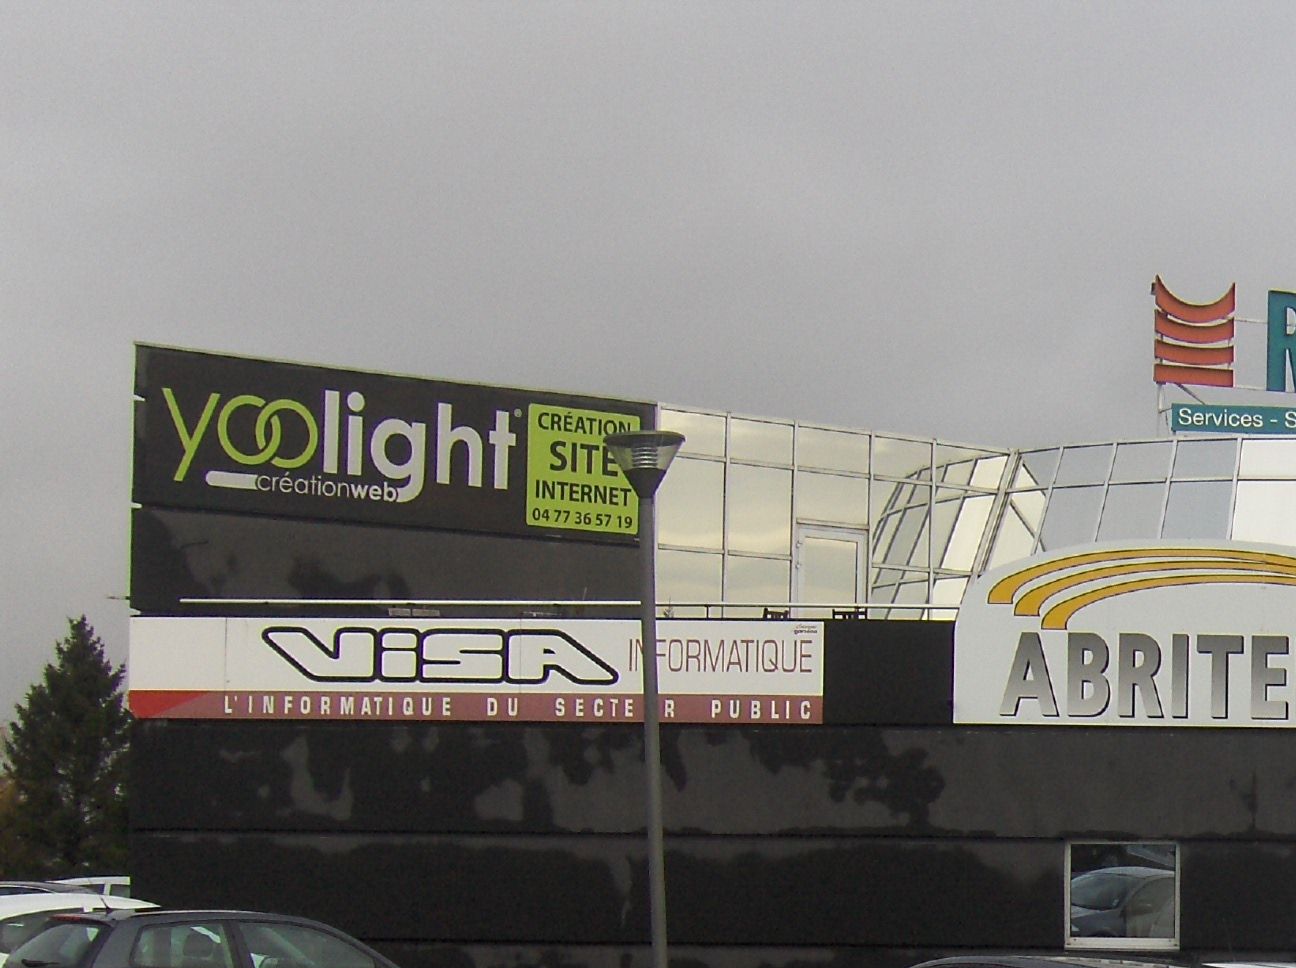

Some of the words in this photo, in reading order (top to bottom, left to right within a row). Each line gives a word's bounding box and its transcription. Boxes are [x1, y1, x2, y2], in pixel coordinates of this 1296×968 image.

[1178, 407, 1263, 428] Services
[161, 387, 516, 503] yoolight
[549, 440, 619, 477] SITE
[535, 479, 632, 507] INTERNET
[532, 508, 550, 521] 04
[554, 510, 570, 523] 77
[575, 512, 592, 525] 36
[596, 514, 612, 527] 57
[617, 516, 633, 529] 19
[224, 695, 451, 718] L'INFORMATIQUE
[487, 697, 519, 717] DU
[555, 697, 675, 718] SECTER
[711, 699, 811, 720] PUBLIC
